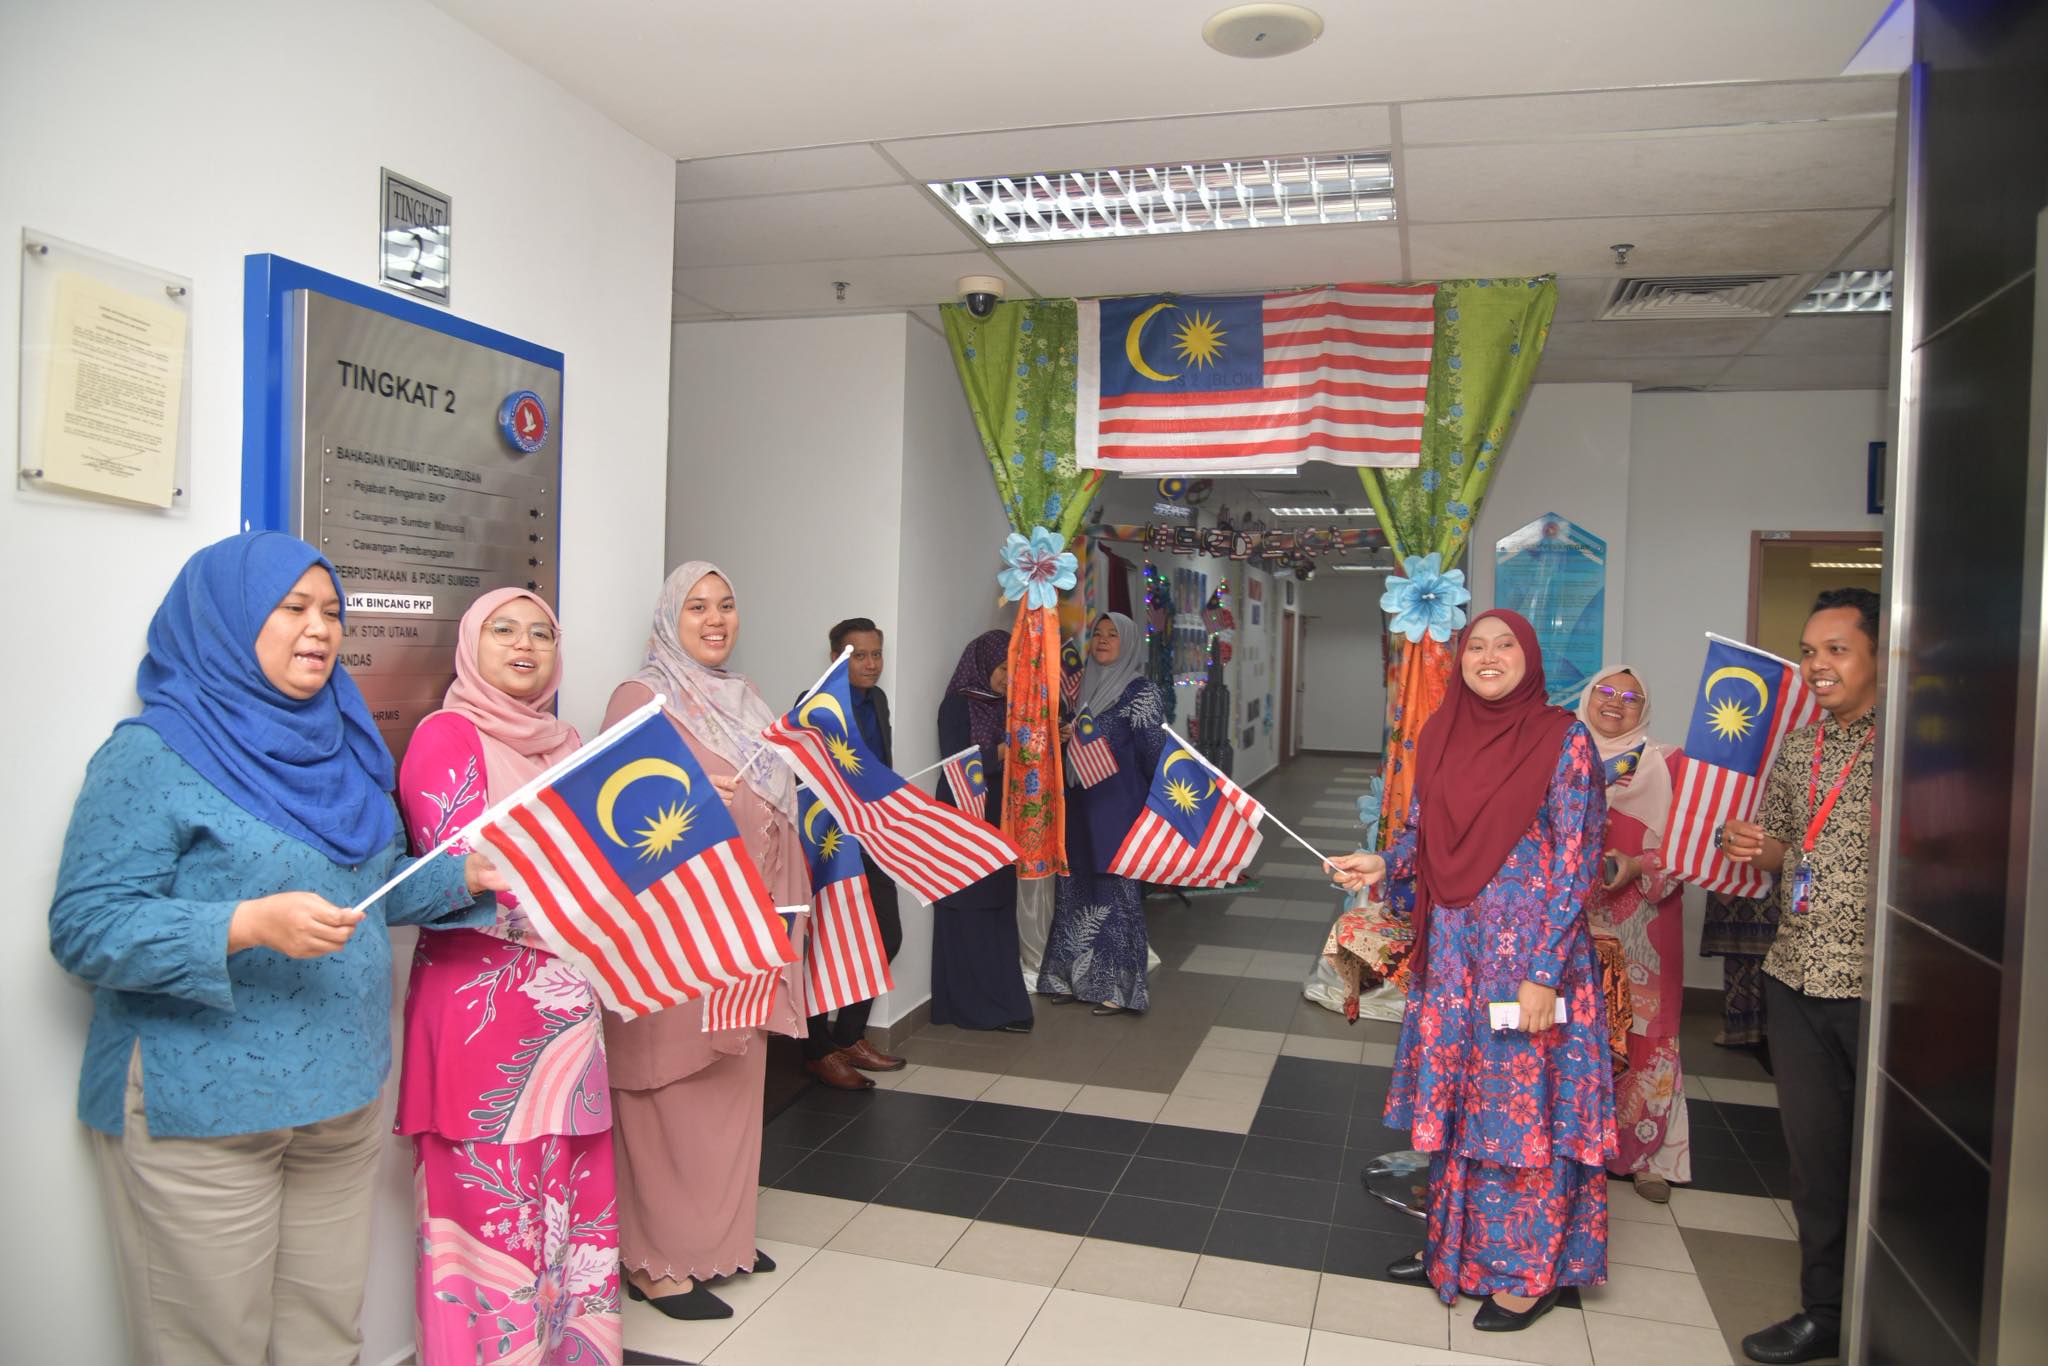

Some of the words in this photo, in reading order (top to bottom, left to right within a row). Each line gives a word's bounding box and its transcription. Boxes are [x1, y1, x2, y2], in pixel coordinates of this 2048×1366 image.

[394, 191, 443, 234] TINGKAT
[337, 360, 438, 408] TINGKAT
[444, 390, 456, 413] 2
[336, 447, 385, 467] BAHAGIAN
[388, 456, 425, 474] KHIDMAT
[427, 463, 482, 483] PENGURUSAN
[353, 510, 398, 526] Cawangan
[400, 516, 431, 528] Sumber
[353, 539, 397, 554] Cawangan
[400, 544, 454, 558] Pembangunan
[335, 565, 407, 582] PERPUSTAKAAN
[412, 572, 417, 583] &
[420, 572, 445, 584] PUSAT
[448, 574, 480, 587] SUMBER
[346, 597, 363, 607] LIK
[366, 598, 410, 609] BINCANG
[413, 600, 432, 610] PKP
[343, 624, 358, 637] LIK
[361, 625, 385, 637] STOR
[388, 626, 418, 638] UTAMA
[373, 710, 400, 720] HRMIS
